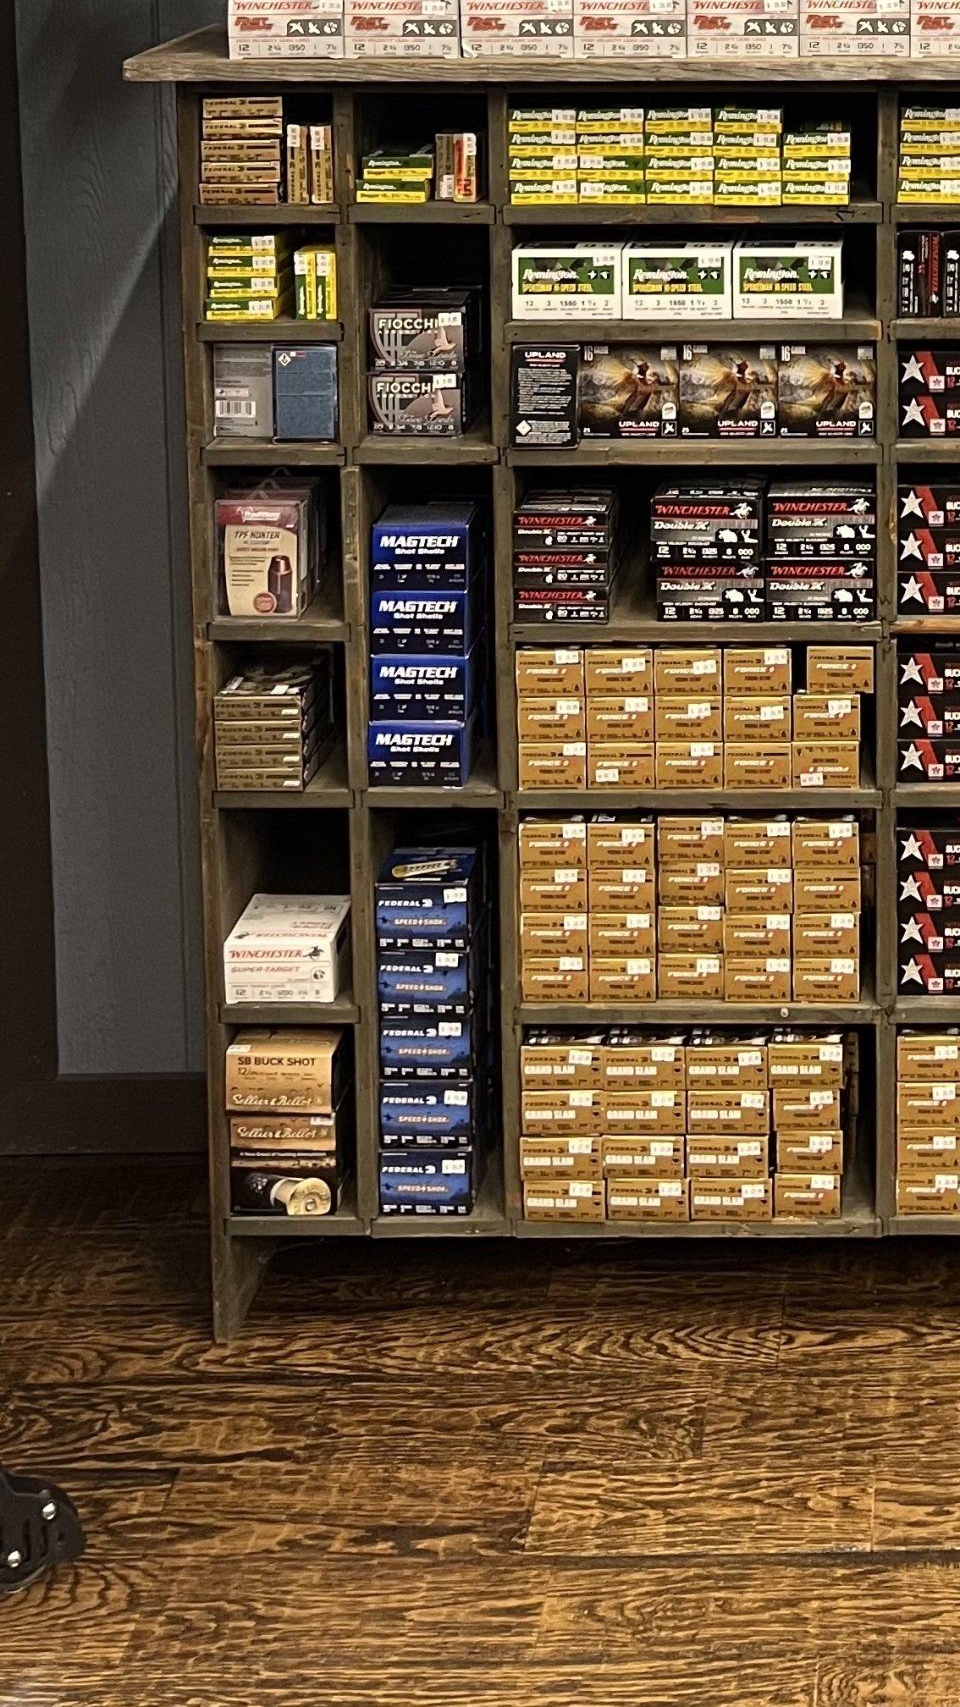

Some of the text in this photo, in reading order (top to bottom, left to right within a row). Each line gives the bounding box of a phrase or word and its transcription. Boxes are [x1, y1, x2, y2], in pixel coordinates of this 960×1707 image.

[467, 0, 544, 12] WINCHESTER
[379, 318, 438, 330] FIOCCHI
[524, 351, 566, 360] UPLAND
[619, 420, 660, 428] UPLAND
[717, 420, 758, 428] UPLAND
[816, 420, 857, 428] UPLAND
[656, 505, 730, 515] WINCHESTER
[773, 502, 847, 513] WINCHESTER
[519, 516, 583, 525] WINCHESTER
[654, 520, 693, 530] Double
[381, 535, 459, 548] MAGTECH
[662, 565, 736, 576] WINCHESTER
[770, 565, 845, 576] WINCHESTER
[769, 581, 809, 591] Double
[519, 590, 584, 601] WINCHESTER
[379, 600, 457, 613] MAGTECH
[379, 666, 458, 679] MAGTECH
[375, 733, 453, 746] MAGTECH
[229, 948, 303, 960] WINCHESTER
[237, 1056, 317, 1067] SB BUCK SHOT
